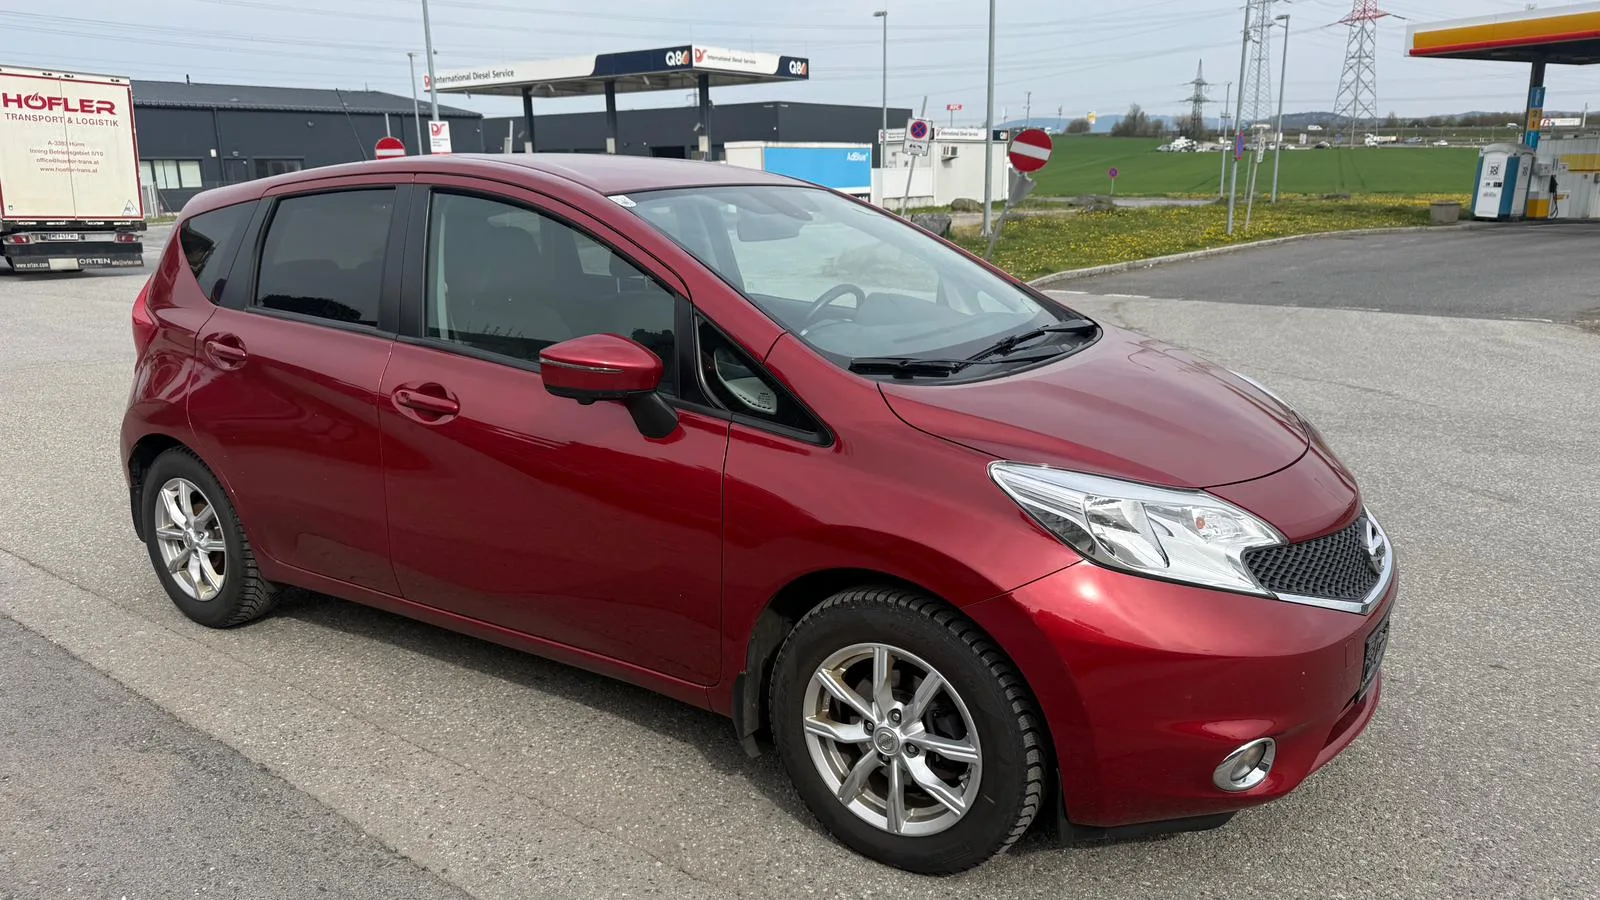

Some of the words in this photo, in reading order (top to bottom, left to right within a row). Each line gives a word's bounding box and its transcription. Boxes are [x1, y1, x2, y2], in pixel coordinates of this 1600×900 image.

[472, 70, 490, 80] Diesel
[492, 68, 514, 78] Service
[2, 92, 117, 115] HÖFLER
[4, 112, 65, 124] TRANSPORT
[67, 116, 73, 124] &
[76, 117, 119, 127] LOGISTIK
[79, 257, 111, 265] ORTEN
